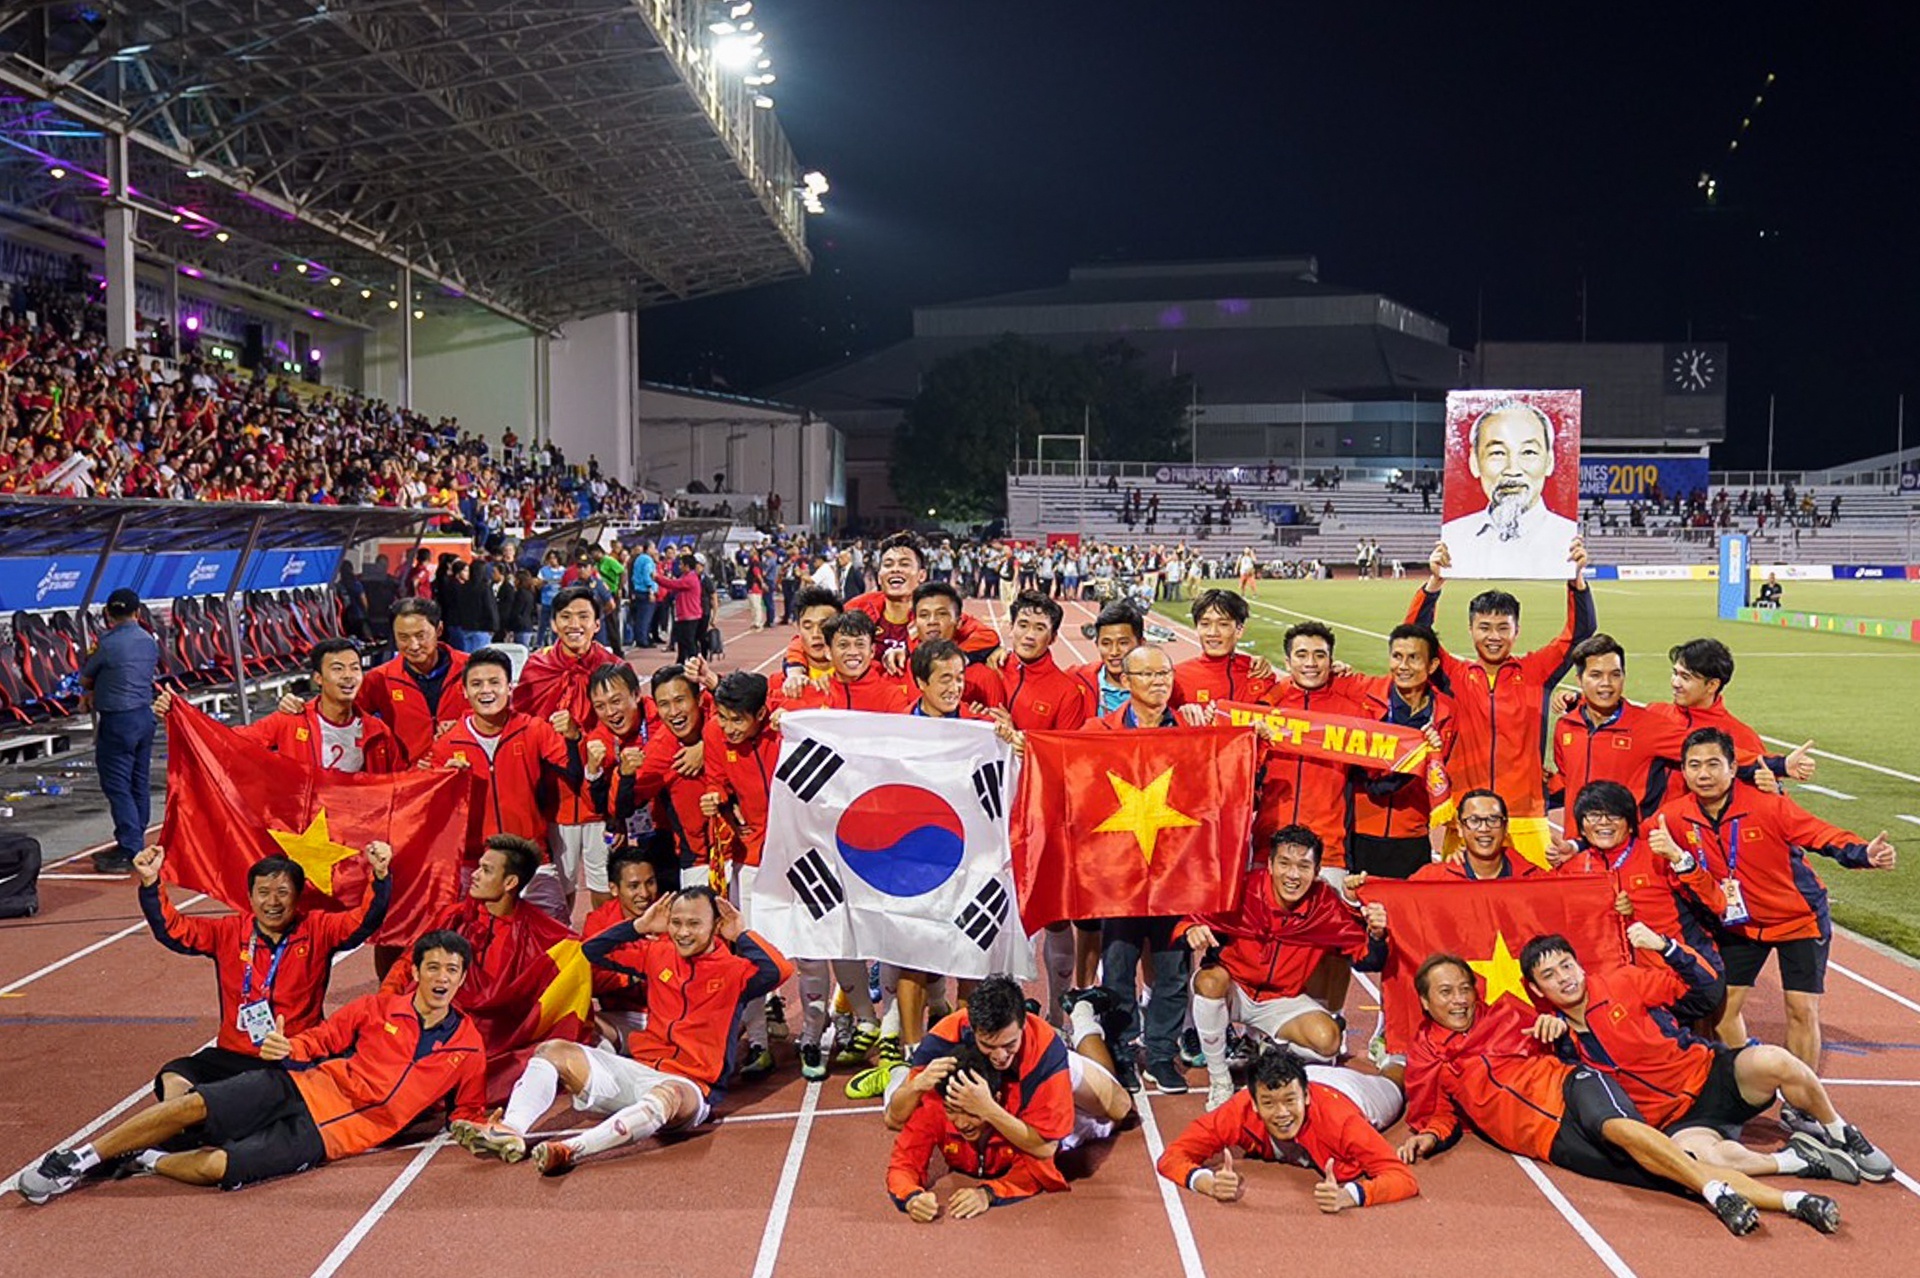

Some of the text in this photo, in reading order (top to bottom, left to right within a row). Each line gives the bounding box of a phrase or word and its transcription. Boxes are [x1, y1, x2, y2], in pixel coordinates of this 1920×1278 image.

[1581, 465, 1658, 494] INES 2019
[1323, 724, 1399, 760] NAM
[331, 744, 345, 770] 2
